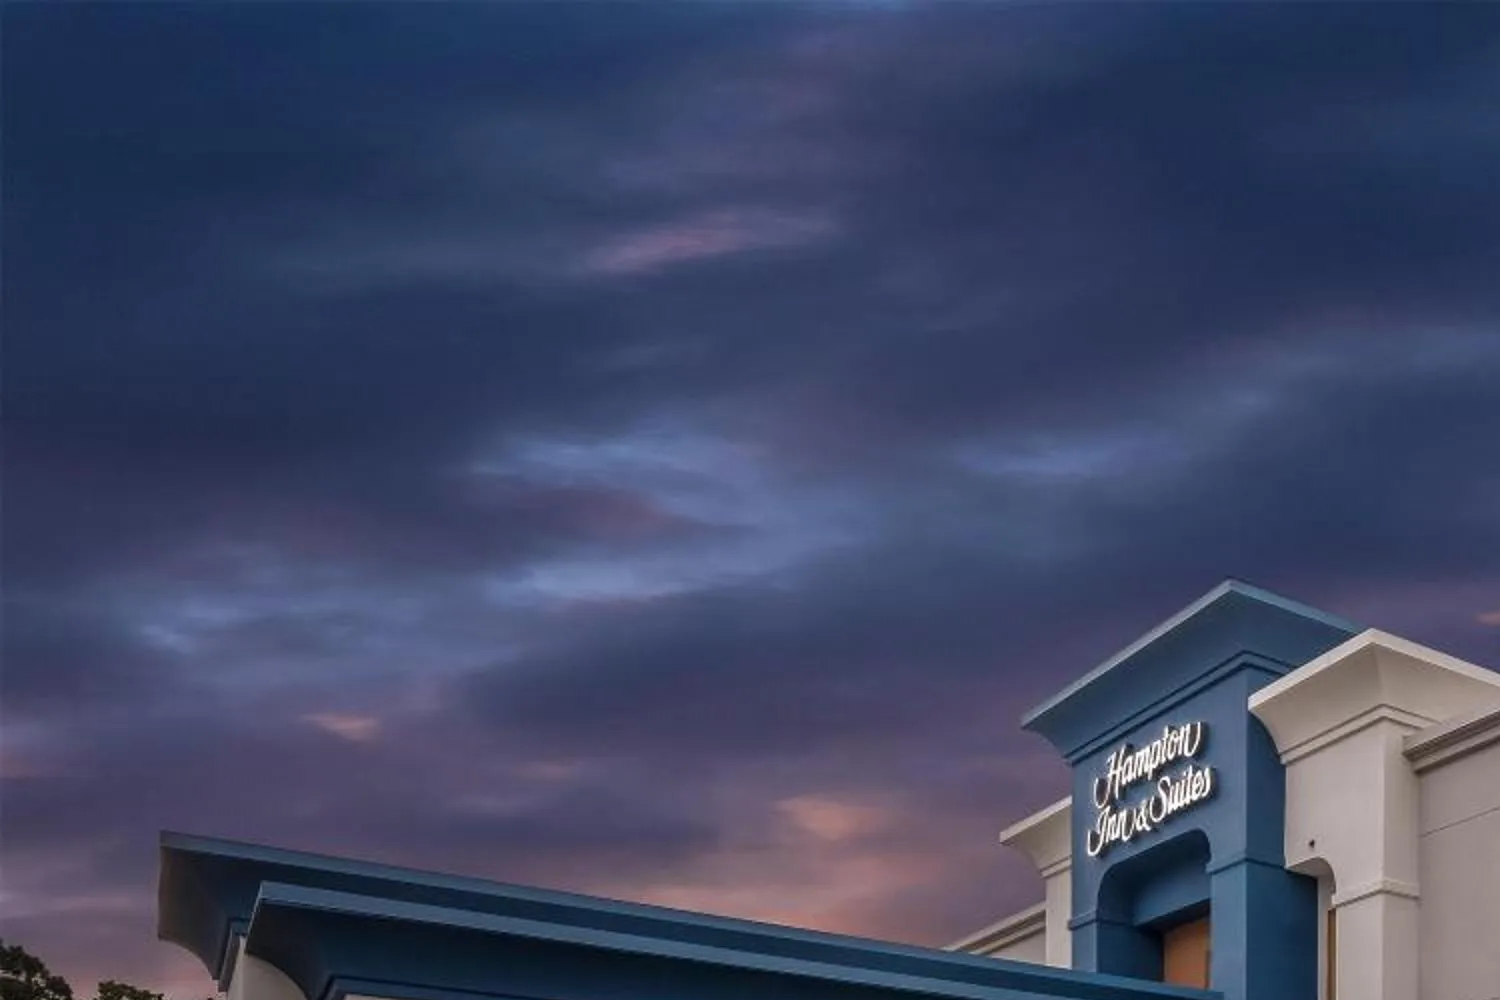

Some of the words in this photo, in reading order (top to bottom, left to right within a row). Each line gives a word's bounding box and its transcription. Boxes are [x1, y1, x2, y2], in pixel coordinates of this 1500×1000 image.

[1093, 721, 1202, 809] Hampton
[1087, 805, 1136, 857] Inn
[1149, 764, 1212, 823] Suites
